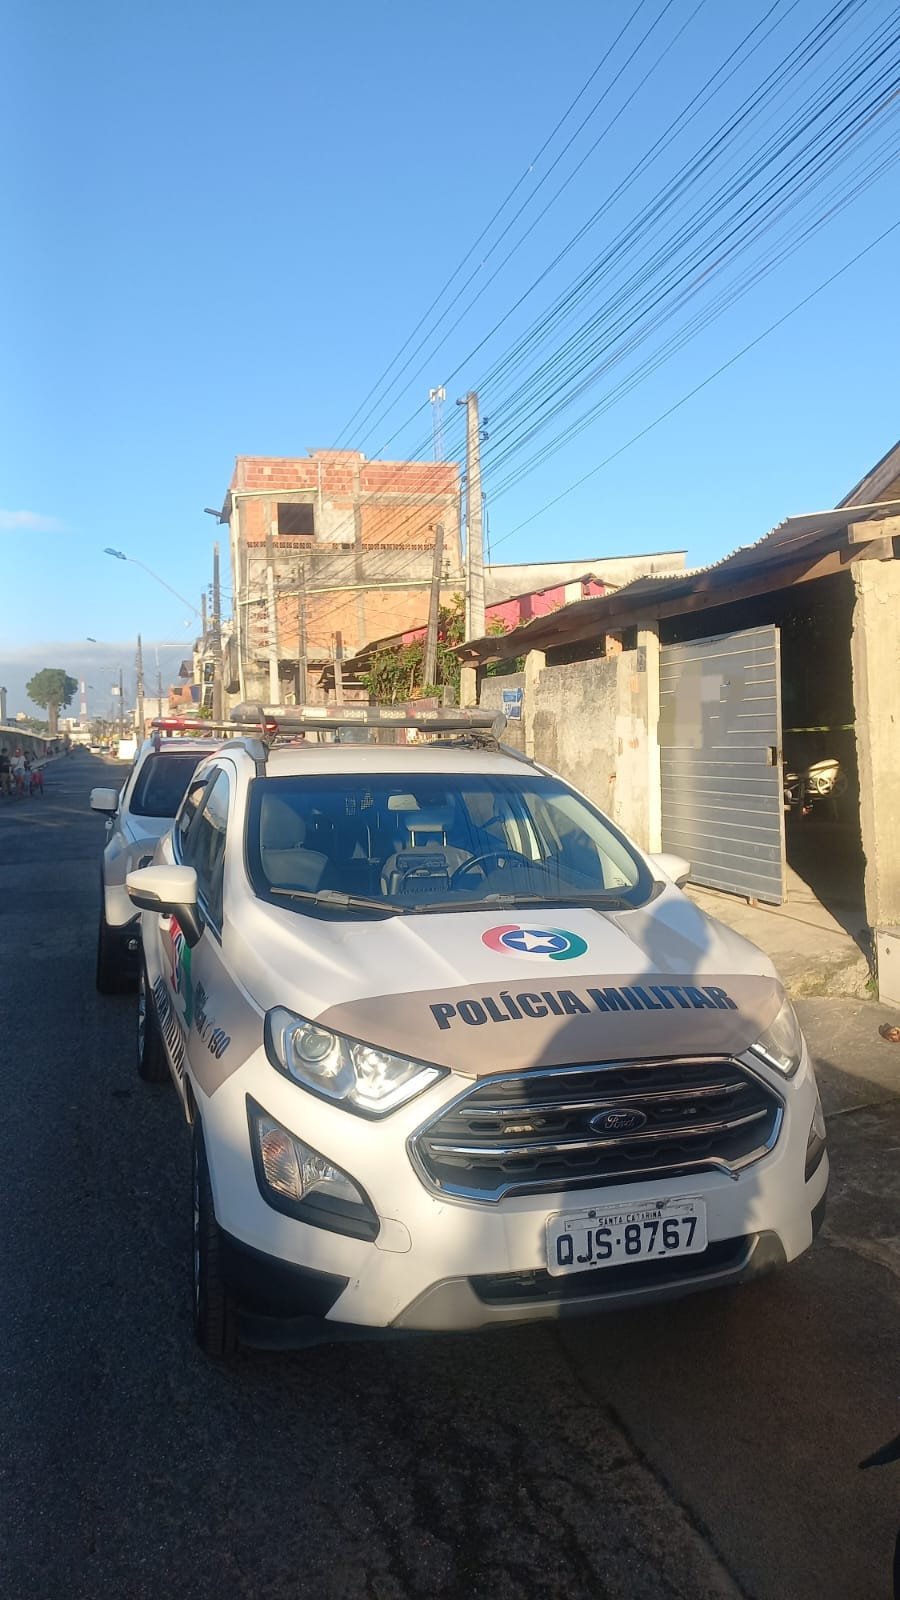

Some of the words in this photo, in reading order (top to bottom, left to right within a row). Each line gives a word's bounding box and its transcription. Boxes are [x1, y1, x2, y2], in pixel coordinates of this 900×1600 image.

[429, 990, 591, 1030] POLÍCIA
[586, 985, 739, 1013] MILITAR
[604, 1113, 636, 1129] Ford
[598, 1215, 623, 1227] SANTA
[626, 1210, 662, 1223] CATARINA
